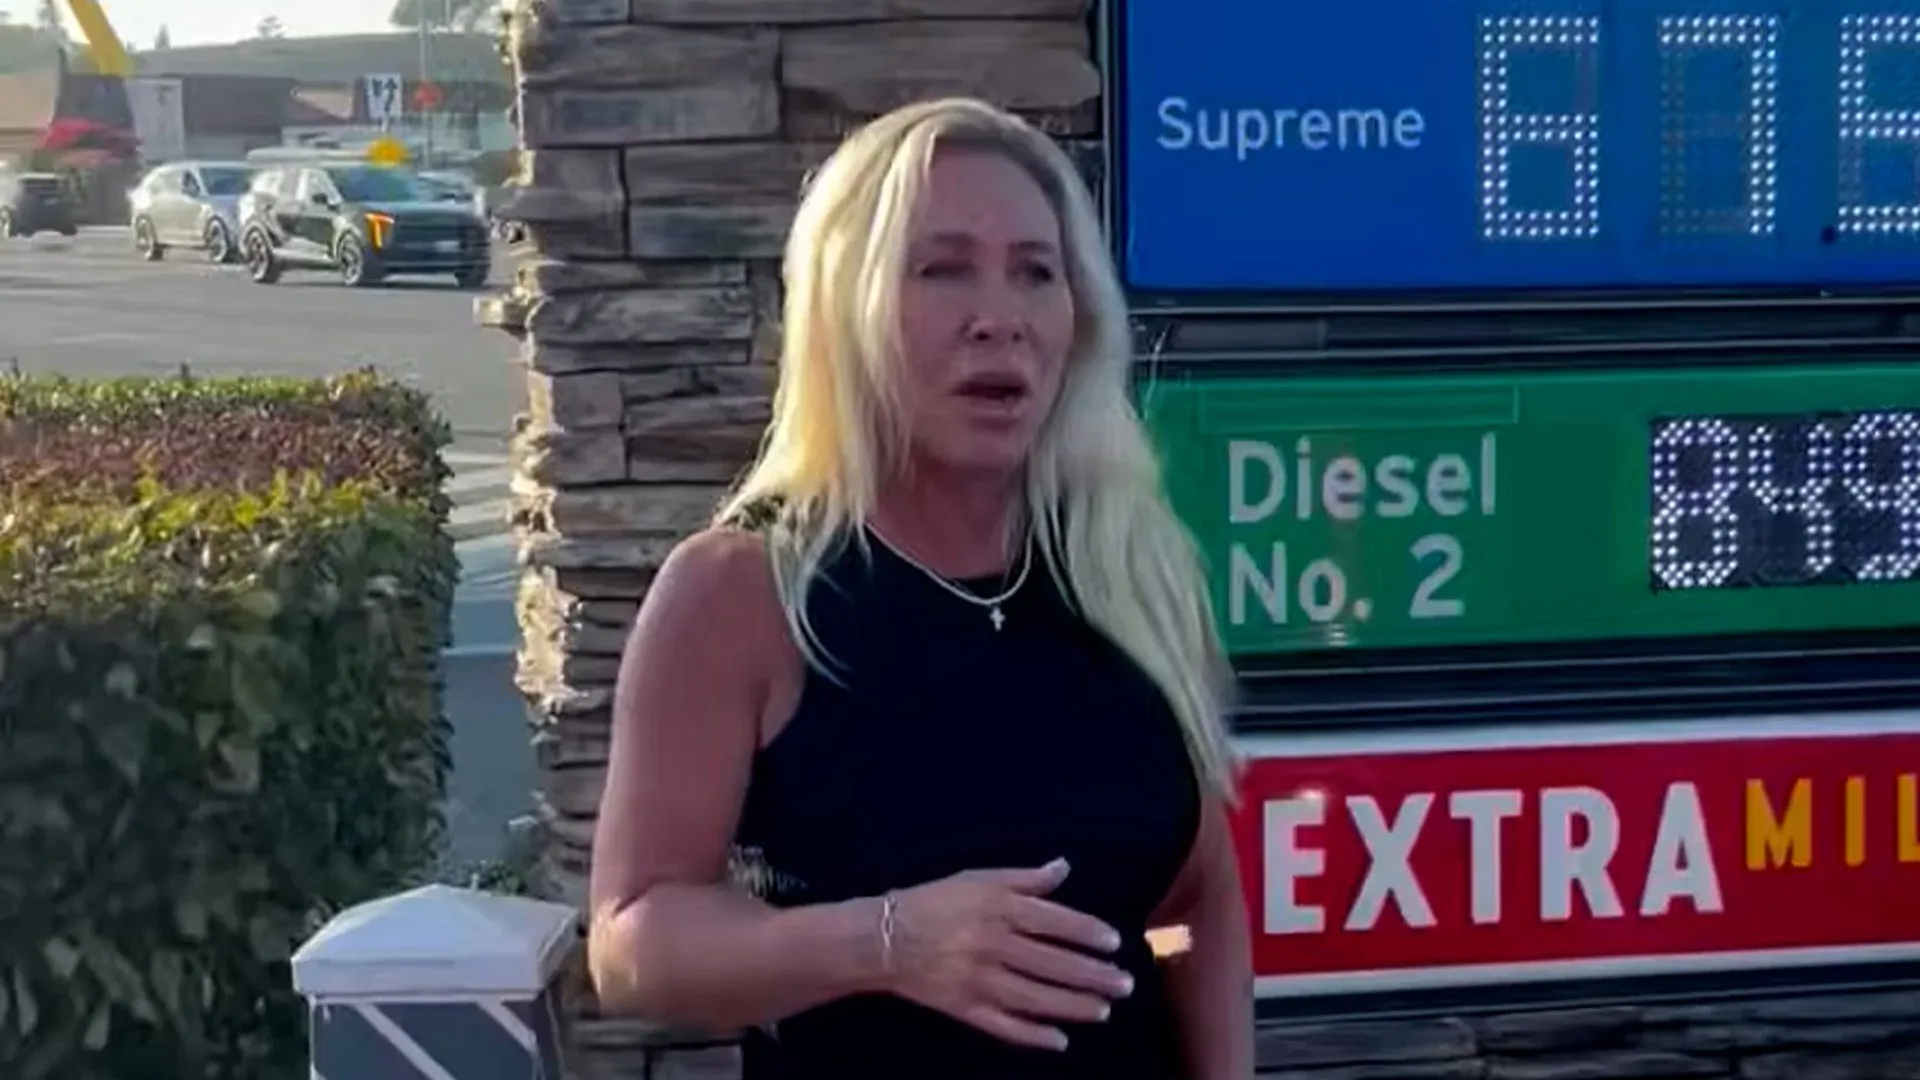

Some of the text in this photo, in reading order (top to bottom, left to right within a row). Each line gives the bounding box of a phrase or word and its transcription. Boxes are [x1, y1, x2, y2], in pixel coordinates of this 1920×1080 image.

[1156, 96, 1426, 162] Supreme
[1228, 431, 1497, 524] Diesel
[1653, 413, 1920, 588] 849
[1229, 532, 1466, 625] No. 2
